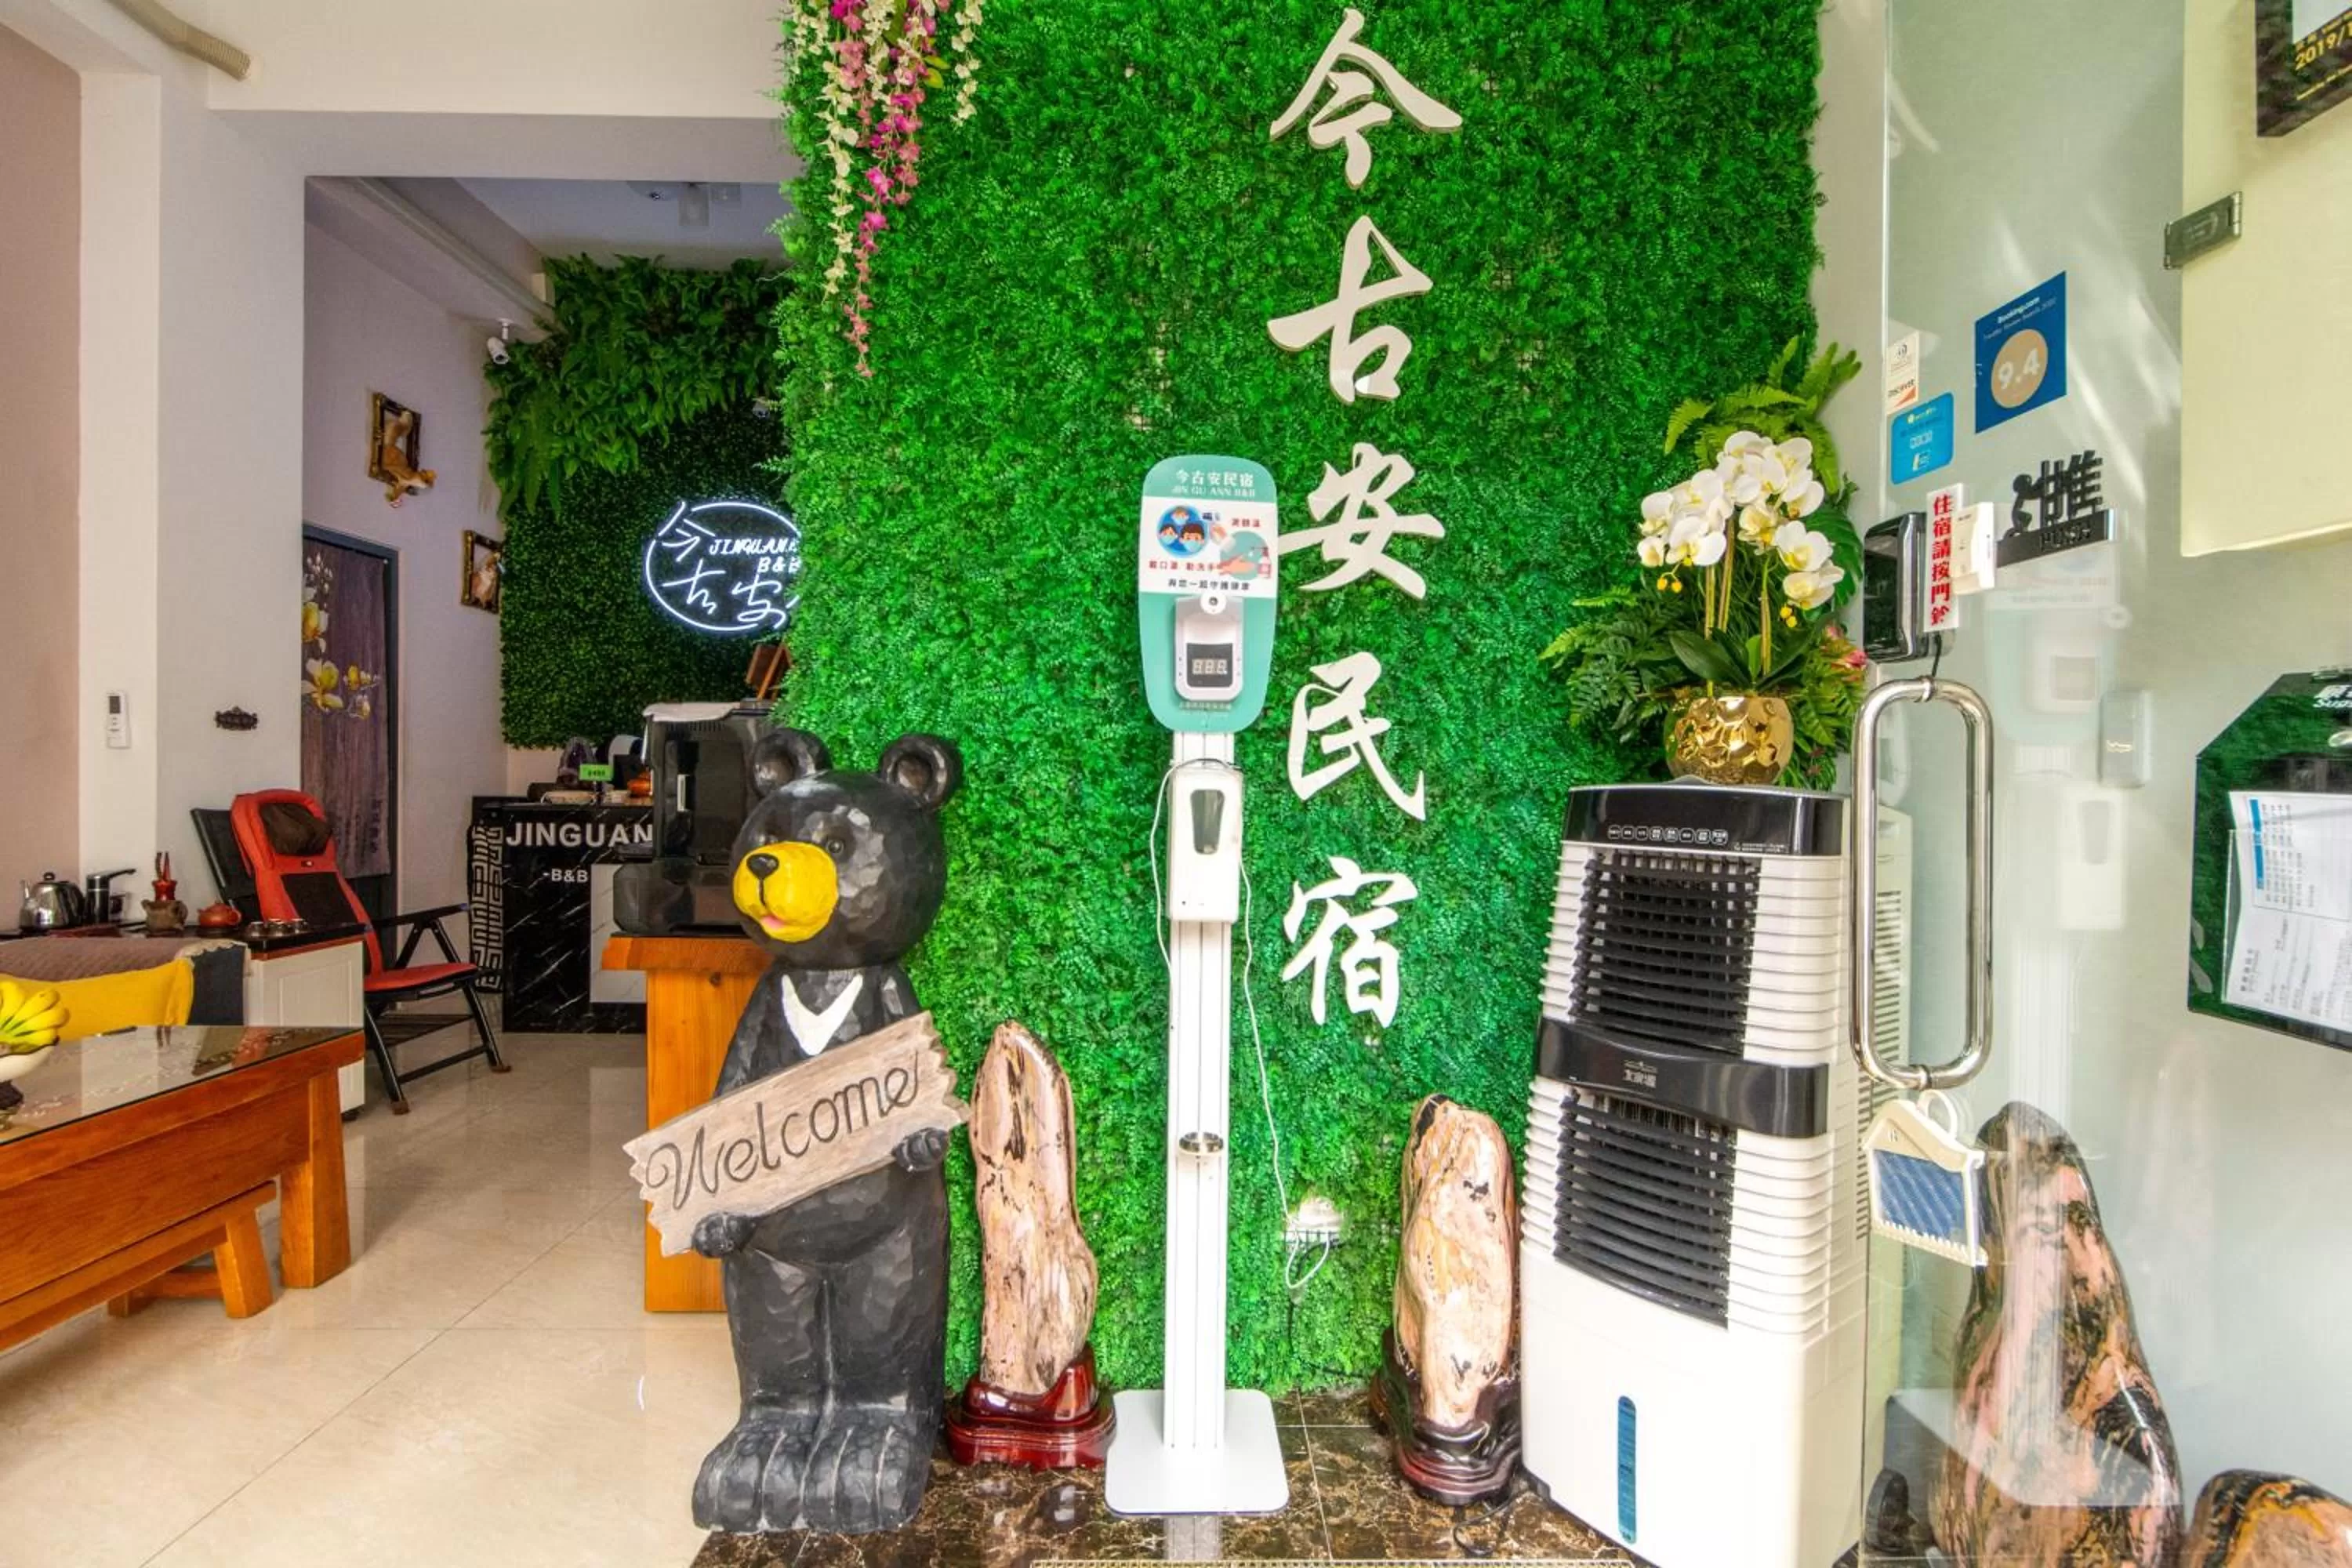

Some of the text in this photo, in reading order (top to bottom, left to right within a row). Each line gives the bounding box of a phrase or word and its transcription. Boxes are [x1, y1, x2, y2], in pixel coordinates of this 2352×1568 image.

[1998, 347, 2040, 390] 9.4
[1177, 470, 1254, 488] 今古安民宿
[1267, 7, 1463, 1029] 今古安民宿
[757, 555, 800, 574] B&B
[551, 868, 588, 883] B&B
[645, 1049, 919, 1210] Welcome
